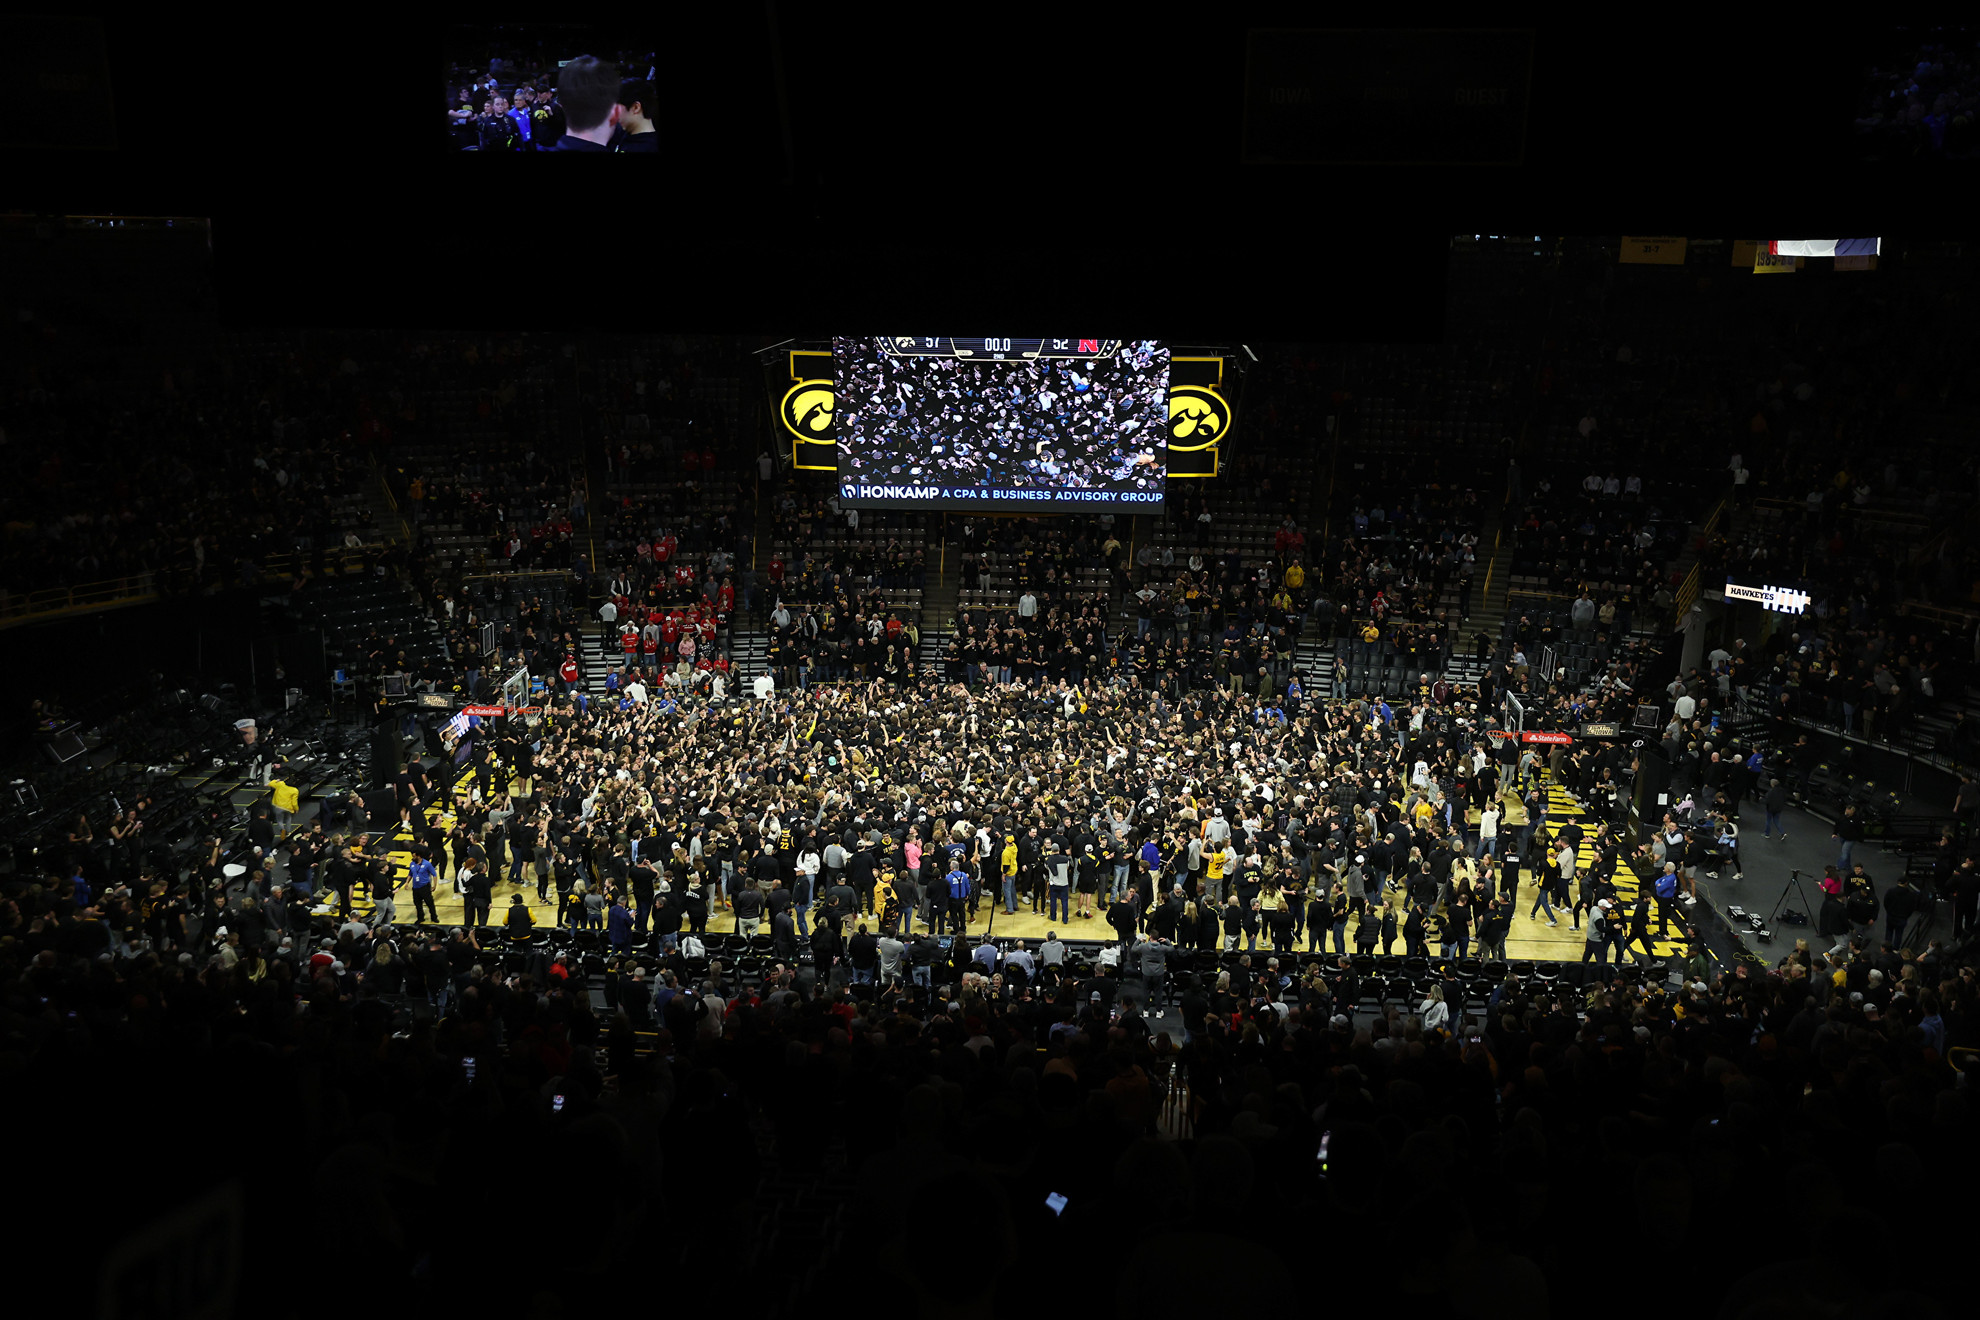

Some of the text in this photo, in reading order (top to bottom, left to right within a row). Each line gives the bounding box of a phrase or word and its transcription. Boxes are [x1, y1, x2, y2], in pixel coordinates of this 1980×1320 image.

[984, 338, 1011, 352] 00.0
[860, 484, 1163, 502] HONKAMP A CPA & BUSINESS ADVISORY GROUP
[1730, 587, 1775, 601] HAWKEYES
[1762, 584, 1807, 615] WIN
[780, 842, 790, 850] 22
